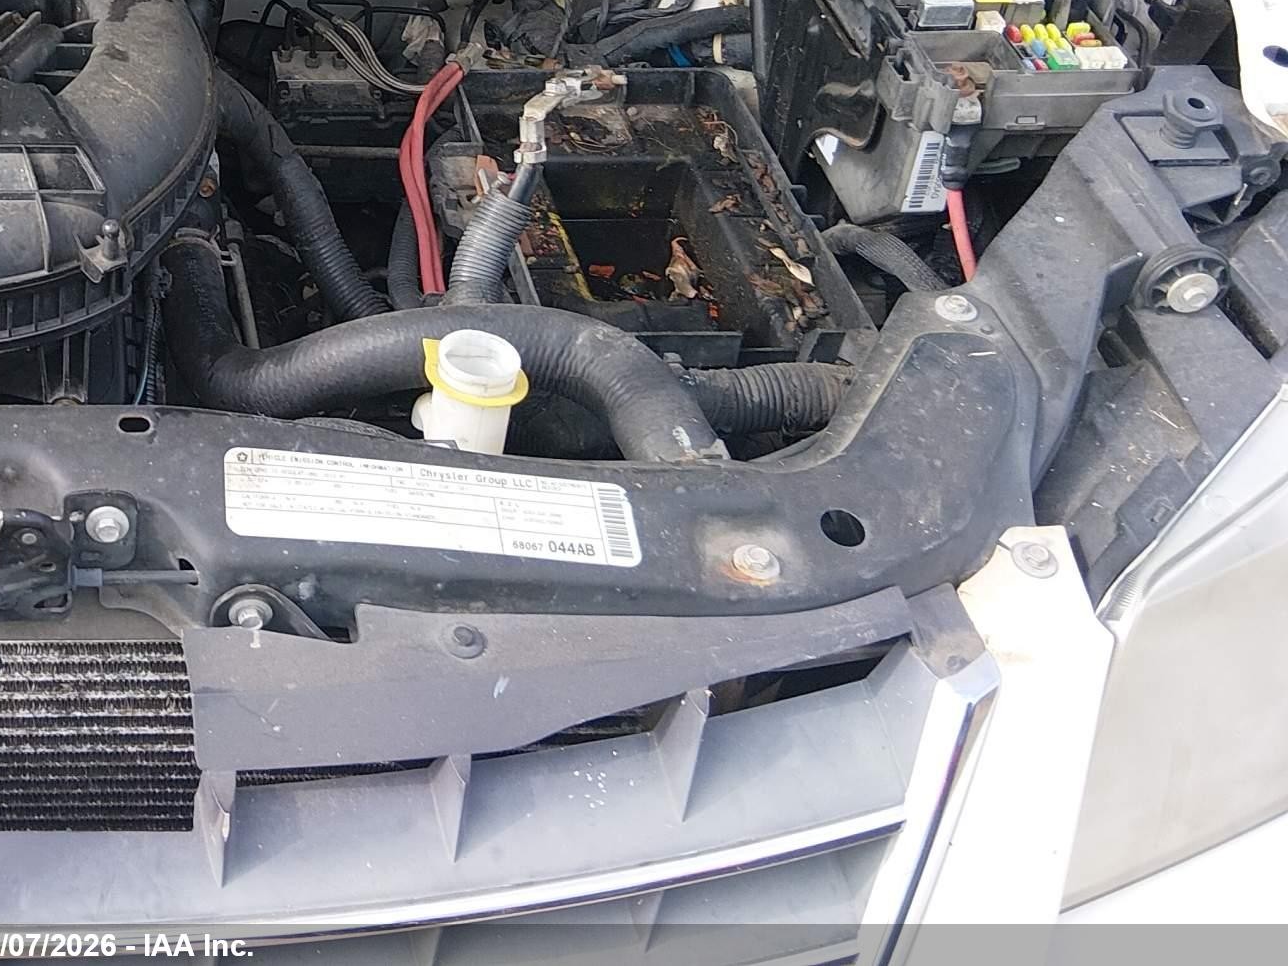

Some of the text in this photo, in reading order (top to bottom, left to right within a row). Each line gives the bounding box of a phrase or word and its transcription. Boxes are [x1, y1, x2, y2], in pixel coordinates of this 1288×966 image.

[419, 468, 469, 483] Chrysler
[475, 474, 508, 487] Group
[513, 477, 533, 489] LLC
[512, 541, 596, 556] 68067 044AB
